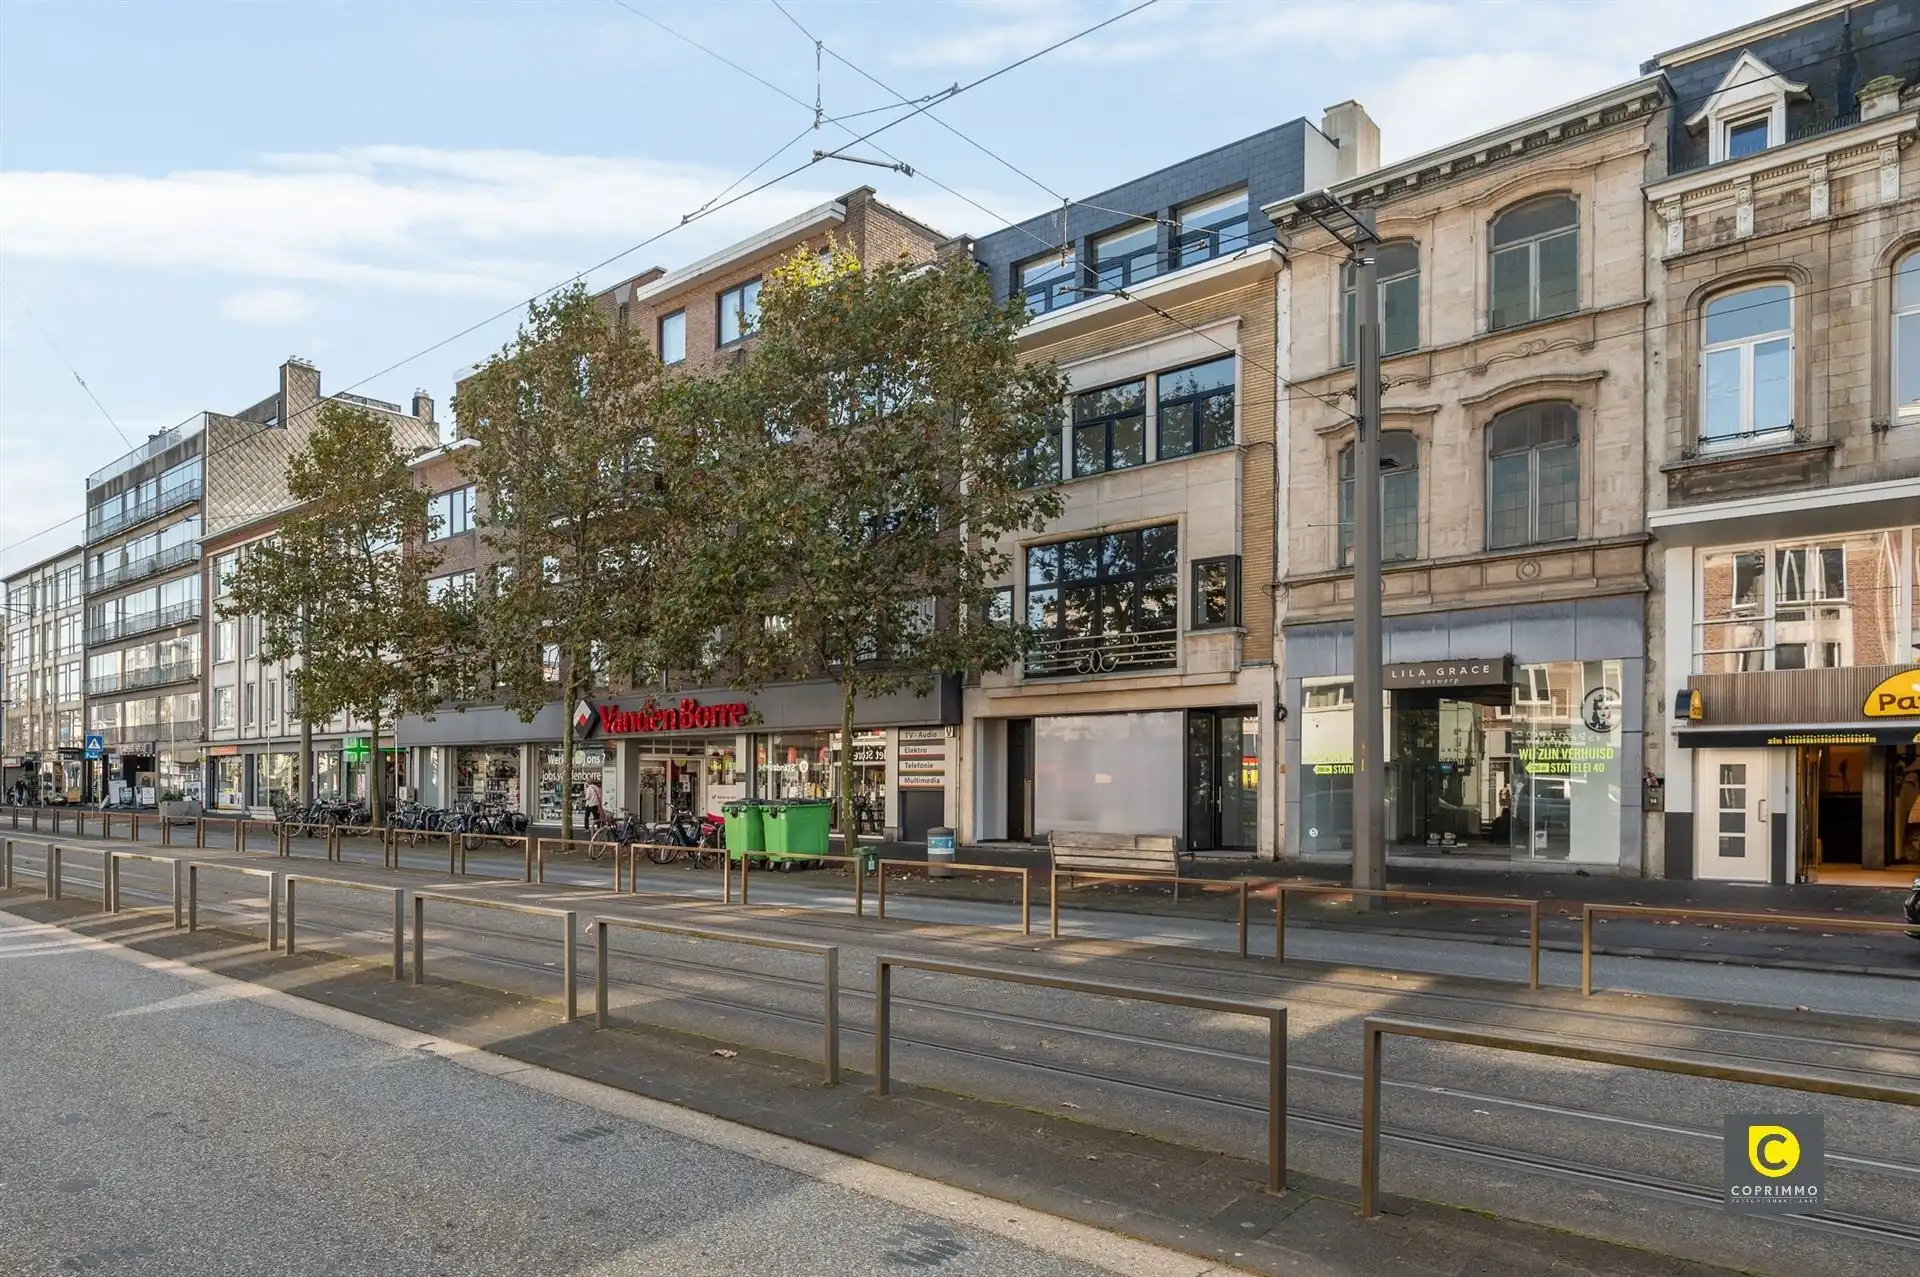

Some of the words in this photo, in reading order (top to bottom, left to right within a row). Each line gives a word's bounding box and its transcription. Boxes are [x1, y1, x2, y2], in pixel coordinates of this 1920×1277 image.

[1391, 668, 1426, 678] LILA
[1436, 665, 1490, 676] GRACE
[1878, 693, 1920, 712] Pa
[904, 746, 928, 754] Elektro
[1518, 748, 1536, 760] WIJ
[1537, 748, 1560, 760] ZIJN
[1560, 747, 1614, 760] VERHUISD
[586, 755, 601, 764] ons
[904, 761, 934, 769] Telefonie
[1550, 762, 1592, 773] STATIELEI
[1592, 762, 1605, 773] 40
[903, 776, 941, 784] Multimedia
